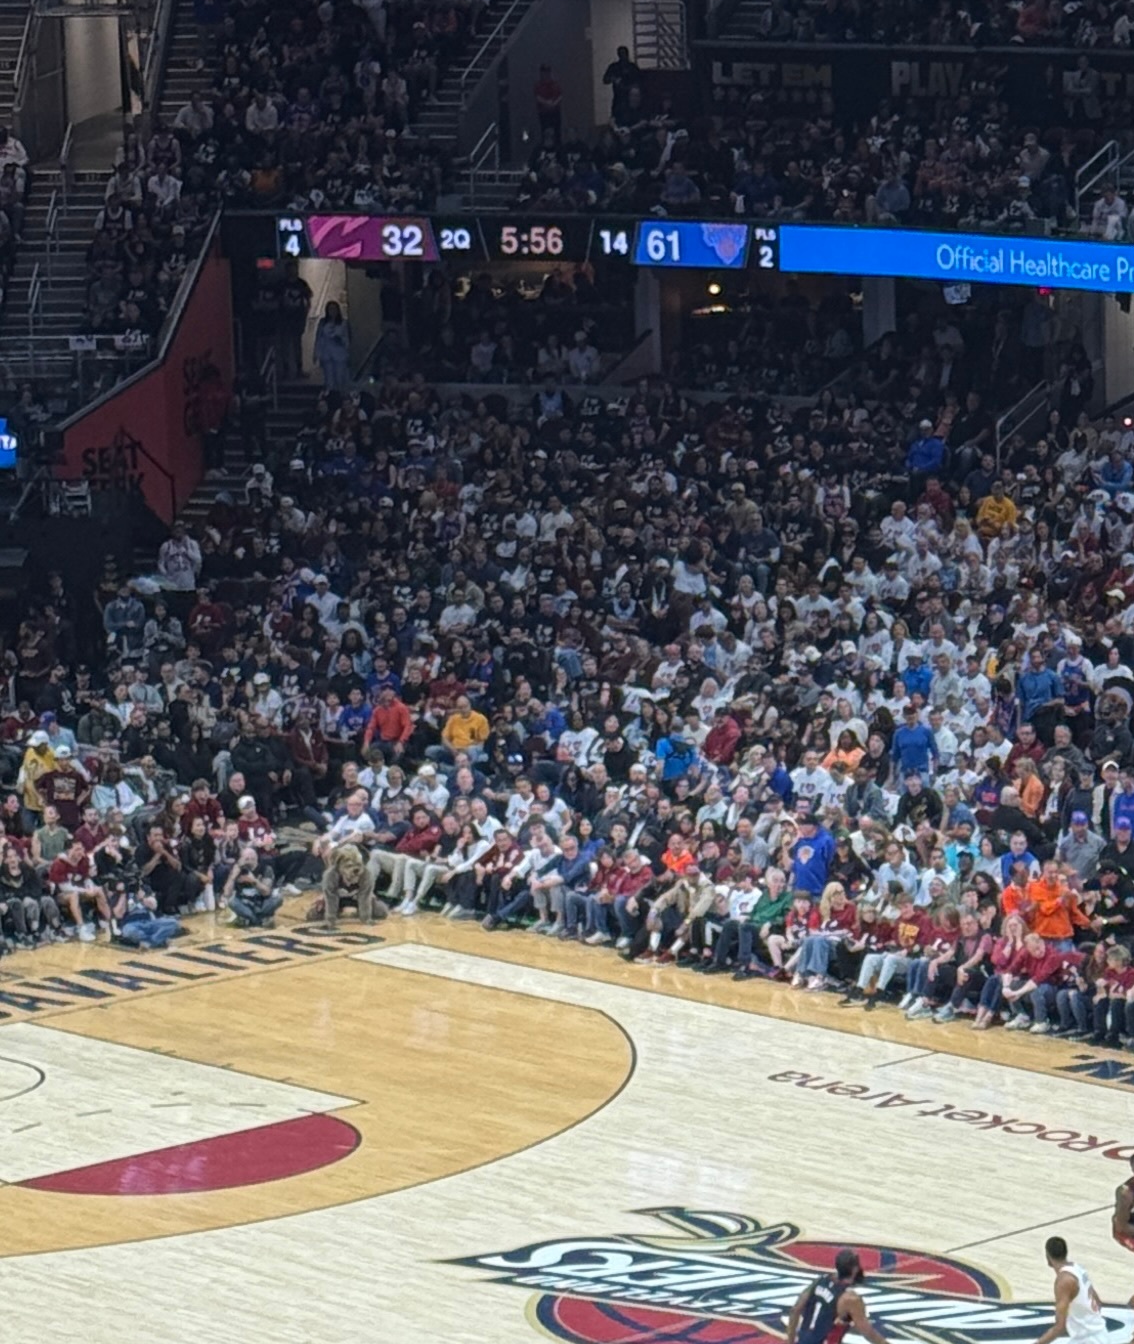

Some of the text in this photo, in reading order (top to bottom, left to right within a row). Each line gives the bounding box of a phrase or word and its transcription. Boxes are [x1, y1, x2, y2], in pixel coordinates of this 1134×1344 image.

[280, 219, 302, 232] FLS
[755, 229, 777, 242] FLS
[285, 239, 300, 257] 4
[381, 225, 423, 256] 32
[440, 229, 471, 251] 2Q
[501, 227, 564, 255] 5:56
[600, 231, 628, 255] 14
[646, 229, 681, 261] 61
[759, 246, 774, 268] 2
[936, 244, 1003, 274] Official
[1010, 252, 1110, 283] Healthcare
[0, 924, 387, 1018] AVALIERS
[767, 1070, 1118, 1153] Rocket Arena
[809, 1302, 821, 1330] 1
